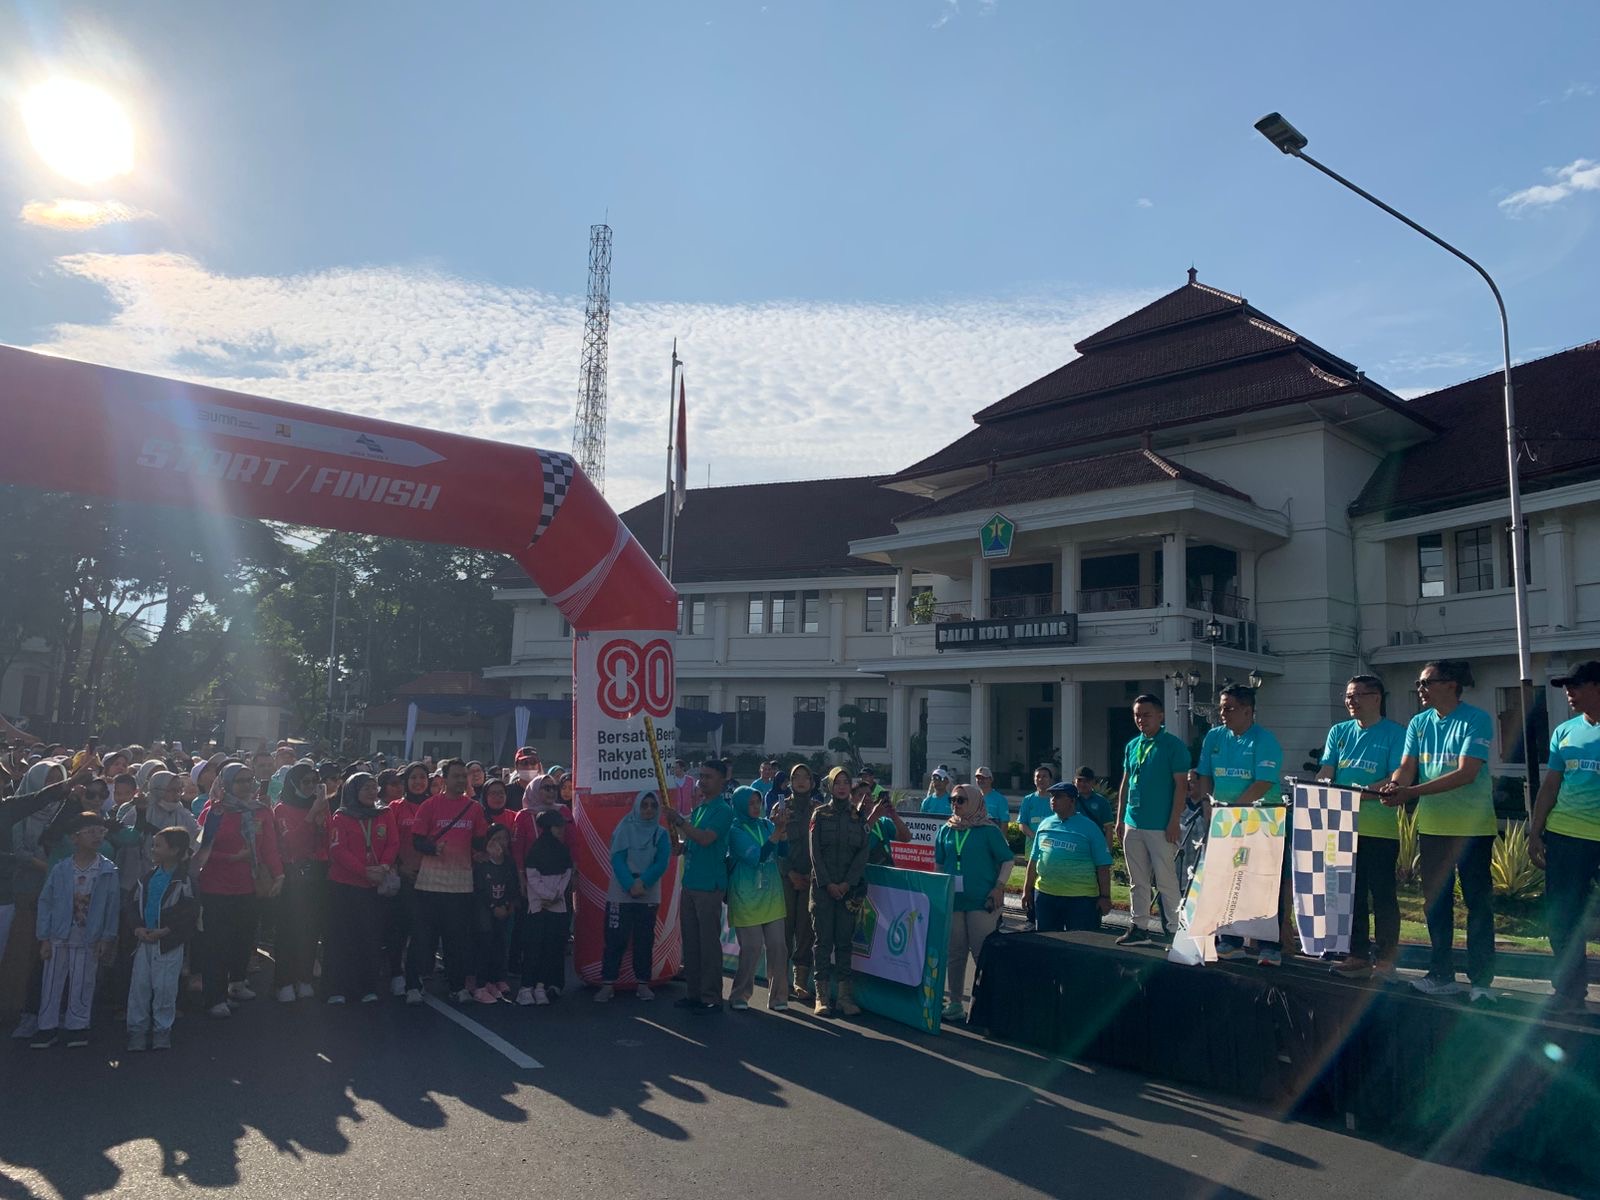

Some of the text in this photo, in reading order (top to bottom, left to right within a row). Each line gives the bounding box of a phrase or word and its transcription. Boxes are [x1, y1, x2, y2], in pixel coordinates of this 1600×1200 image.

[136, 437, 289, 487] START
[310, 467, 441, 511] FINISH
[939, 621, 1068, 642] BALAI KOTA MALANG
[597, 638, 674, 720] 80
[598, 746, 647, 765] Rakyat
